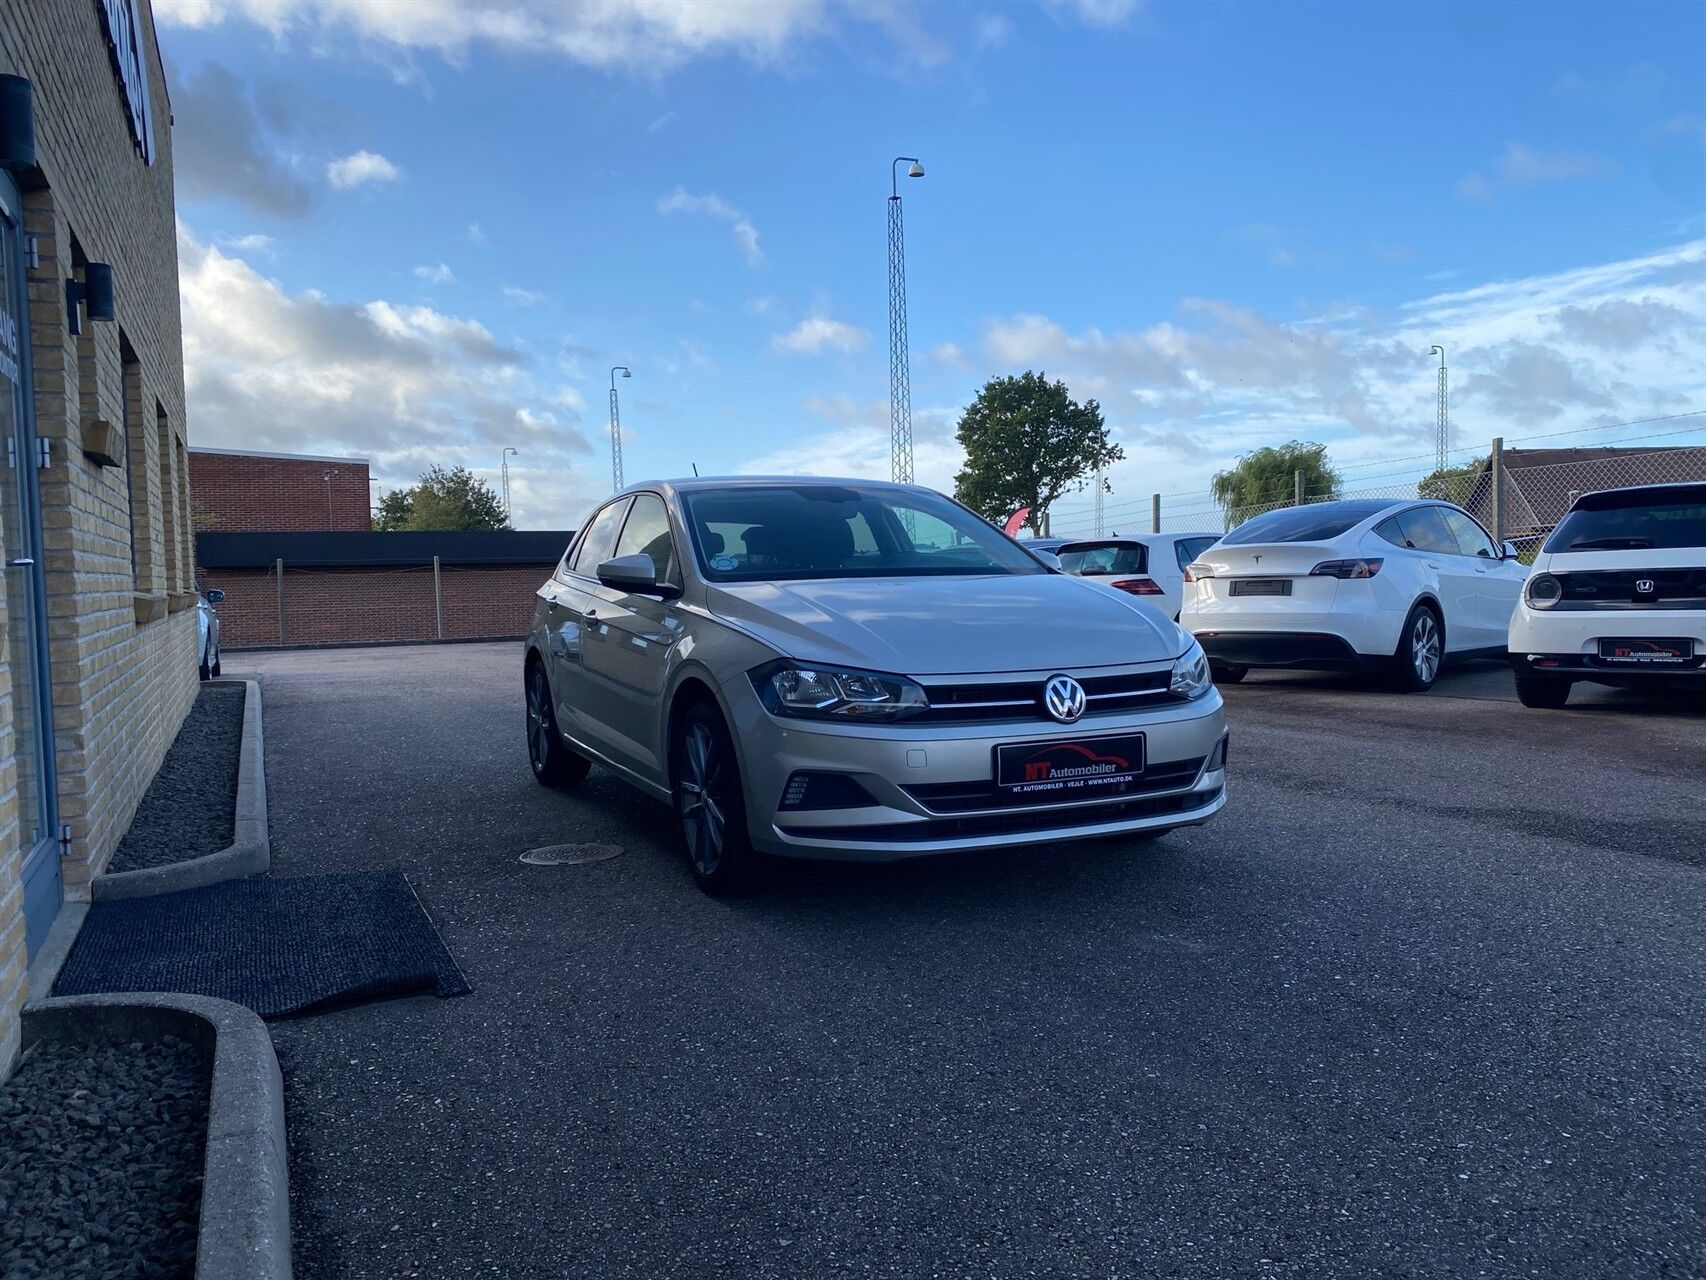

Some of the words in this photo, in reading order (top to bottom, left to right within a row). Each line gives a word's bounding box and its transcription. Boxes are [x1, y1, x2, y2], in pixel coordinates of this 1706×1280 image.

[1025, 761, 1052, 781] NT
[1049, 763, 1117, 779] Automobiler
[1023, 782, 1064, 792] AUTOMOBILER
[1067, 780, 1084, 788] VEJLE
[1088, 775, 1133, 785] WWW.NTAUTO.DK
